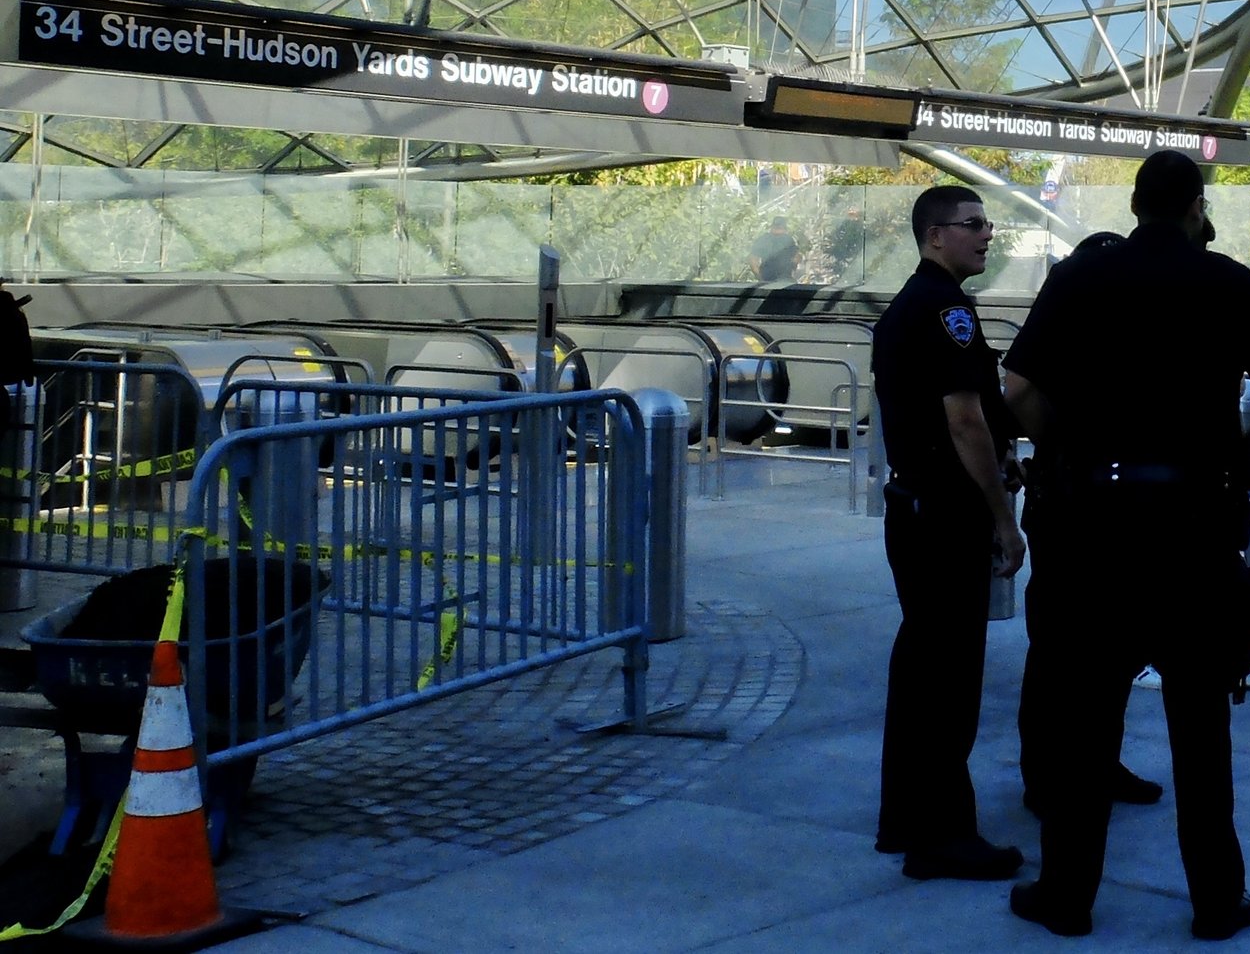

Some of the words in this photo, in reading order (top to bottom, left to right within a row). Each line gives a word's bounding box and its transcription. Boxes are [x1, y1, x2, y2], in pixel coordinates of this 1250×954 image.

[34, 6, 83, 42] 34
[100, 13, 338, 69] Street-Hudson
[352, 42, 429, 79] Yards
[441, 52, 543, 95] Subway
[551, 64, 636, 99] Station
[650, 85, 662, 106] 7
[940, 105, 1052, 138] Street-Hudson
[1058, 117, 1096, 142] Yards
[1100, 121, 1153, 150] Subway
[1155, 126, 1200, 150] Station
[1206, 138, 1213, 154] 7
